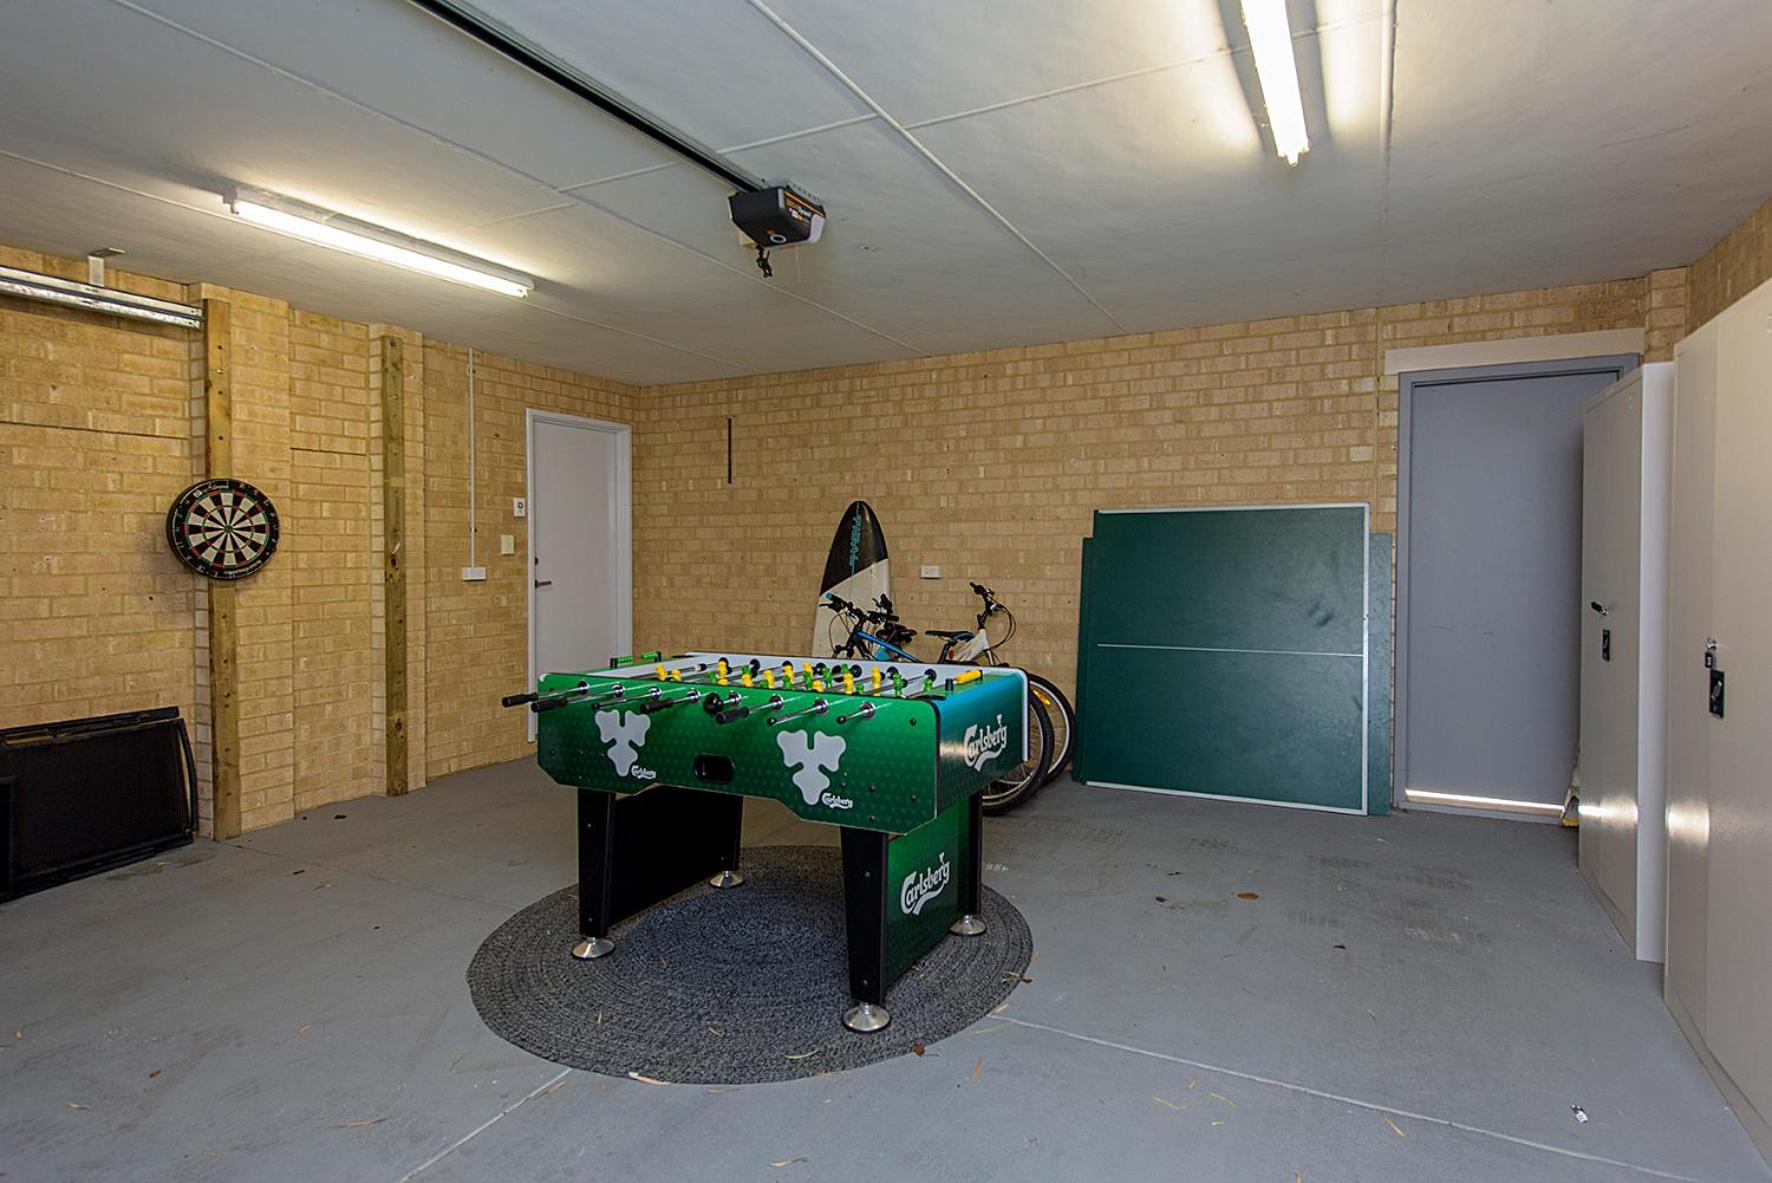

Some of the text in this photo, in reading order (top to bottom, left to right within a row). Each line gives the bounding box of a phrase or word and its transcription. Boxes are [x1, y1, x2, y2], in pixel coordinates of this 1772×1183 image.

[964, 714, 1007, 771] Carlsberg
[631, 765, 656, 779] Carlsberg
[822, 792, 853, 809] Carlsberg
[900, 852, 950, 915] Carlsberg
